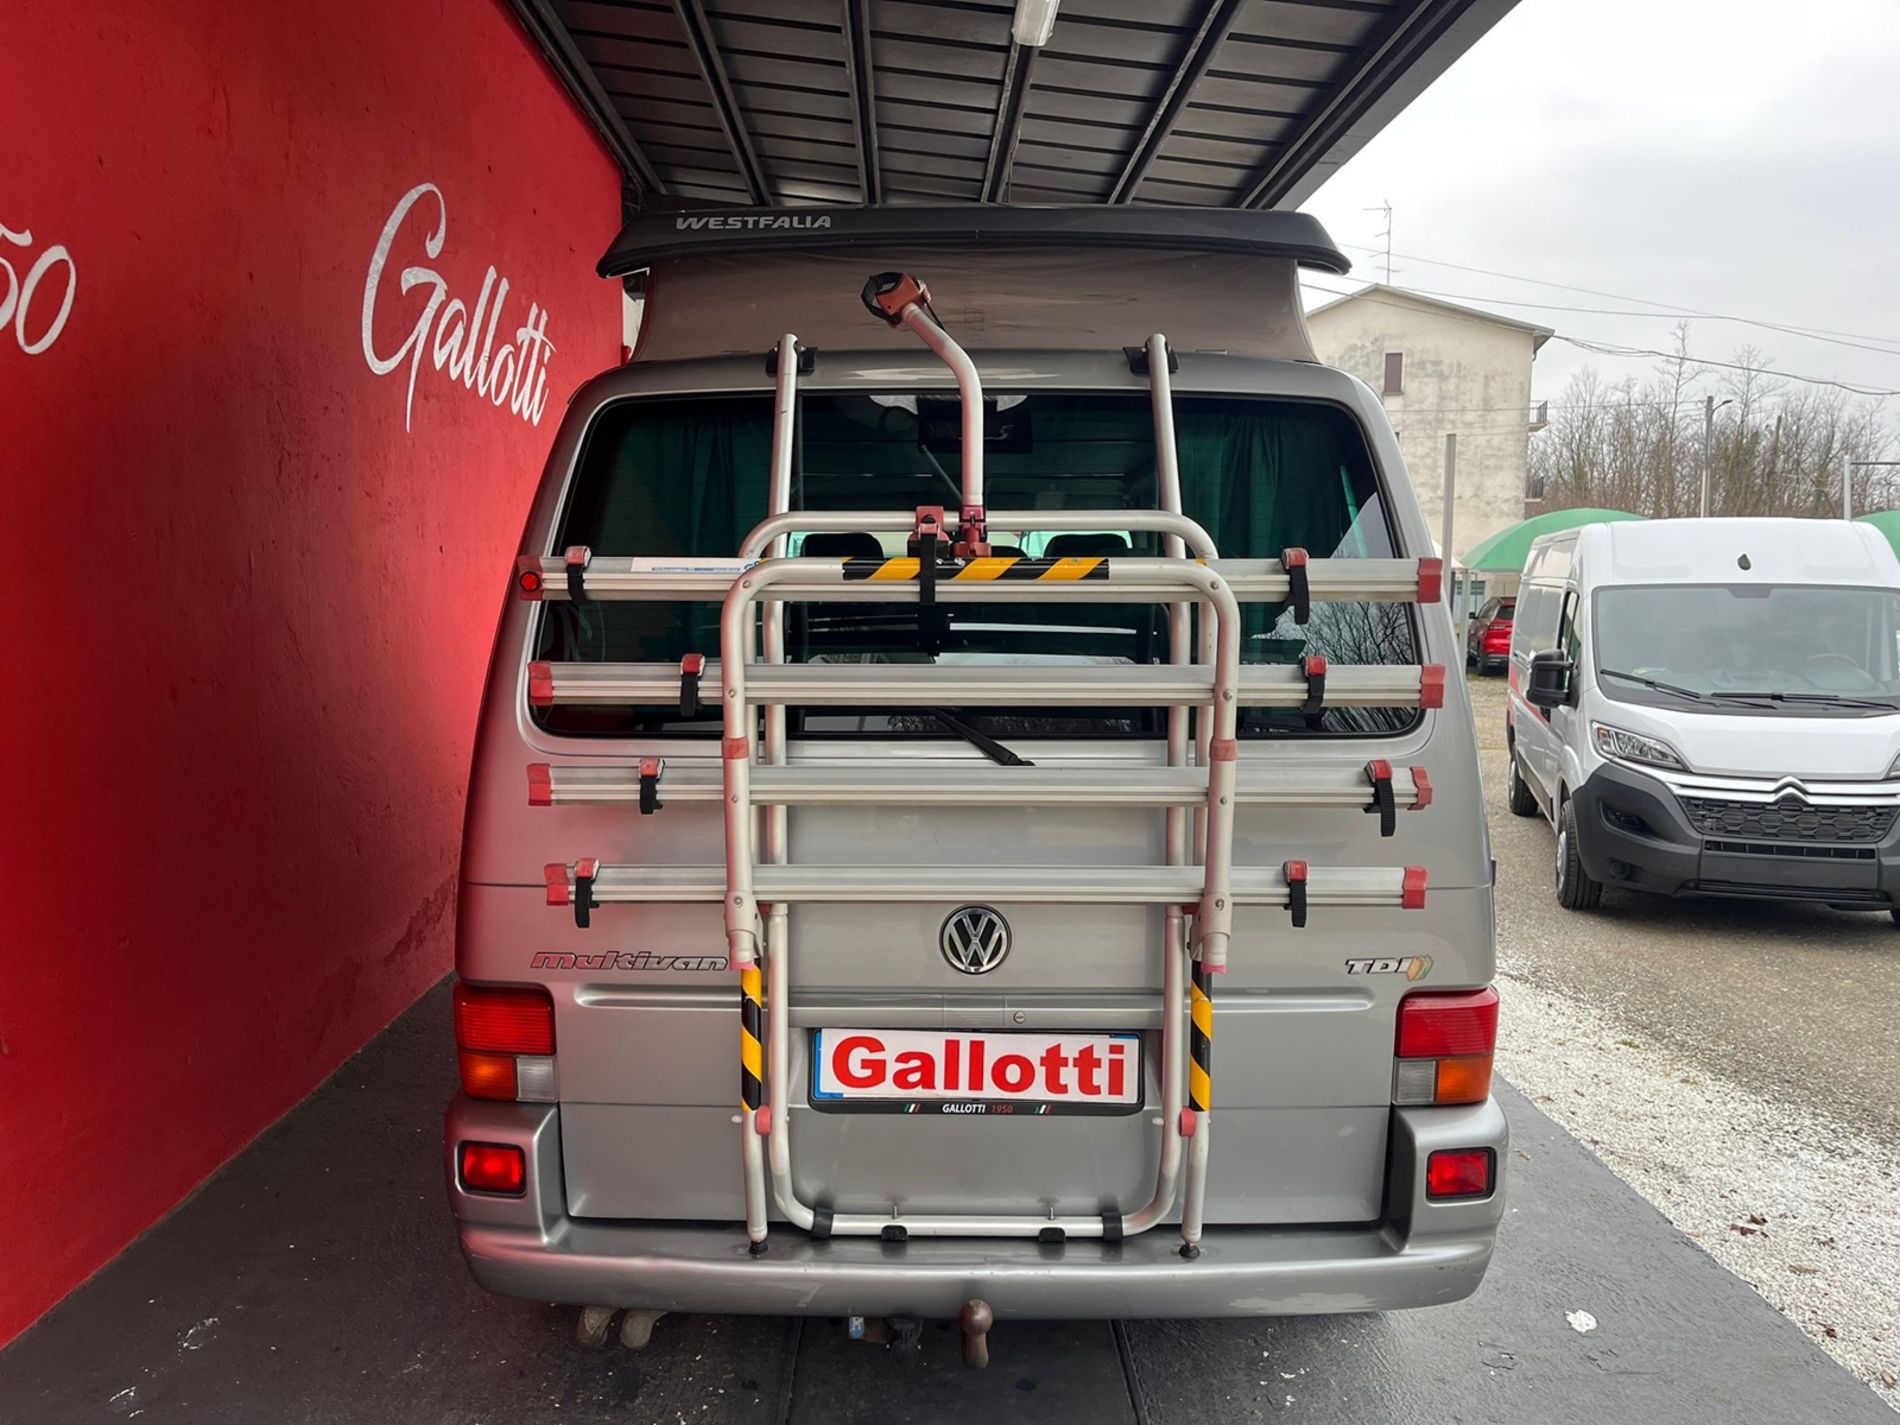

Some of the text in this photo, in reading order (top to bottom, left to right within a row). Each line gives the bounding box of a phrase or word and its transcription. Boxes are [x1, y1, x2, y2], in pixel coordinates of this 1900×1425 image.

[675, 215, 832, 231] WESTFALIA
[361, 183, 557, 433] Gallotti
[1345, 957, 1414, 975] TDI
[831, 1035, 1126, 1097] Gallotti
[942, 1103, 1014, 1114] GALLOTTI 1950
